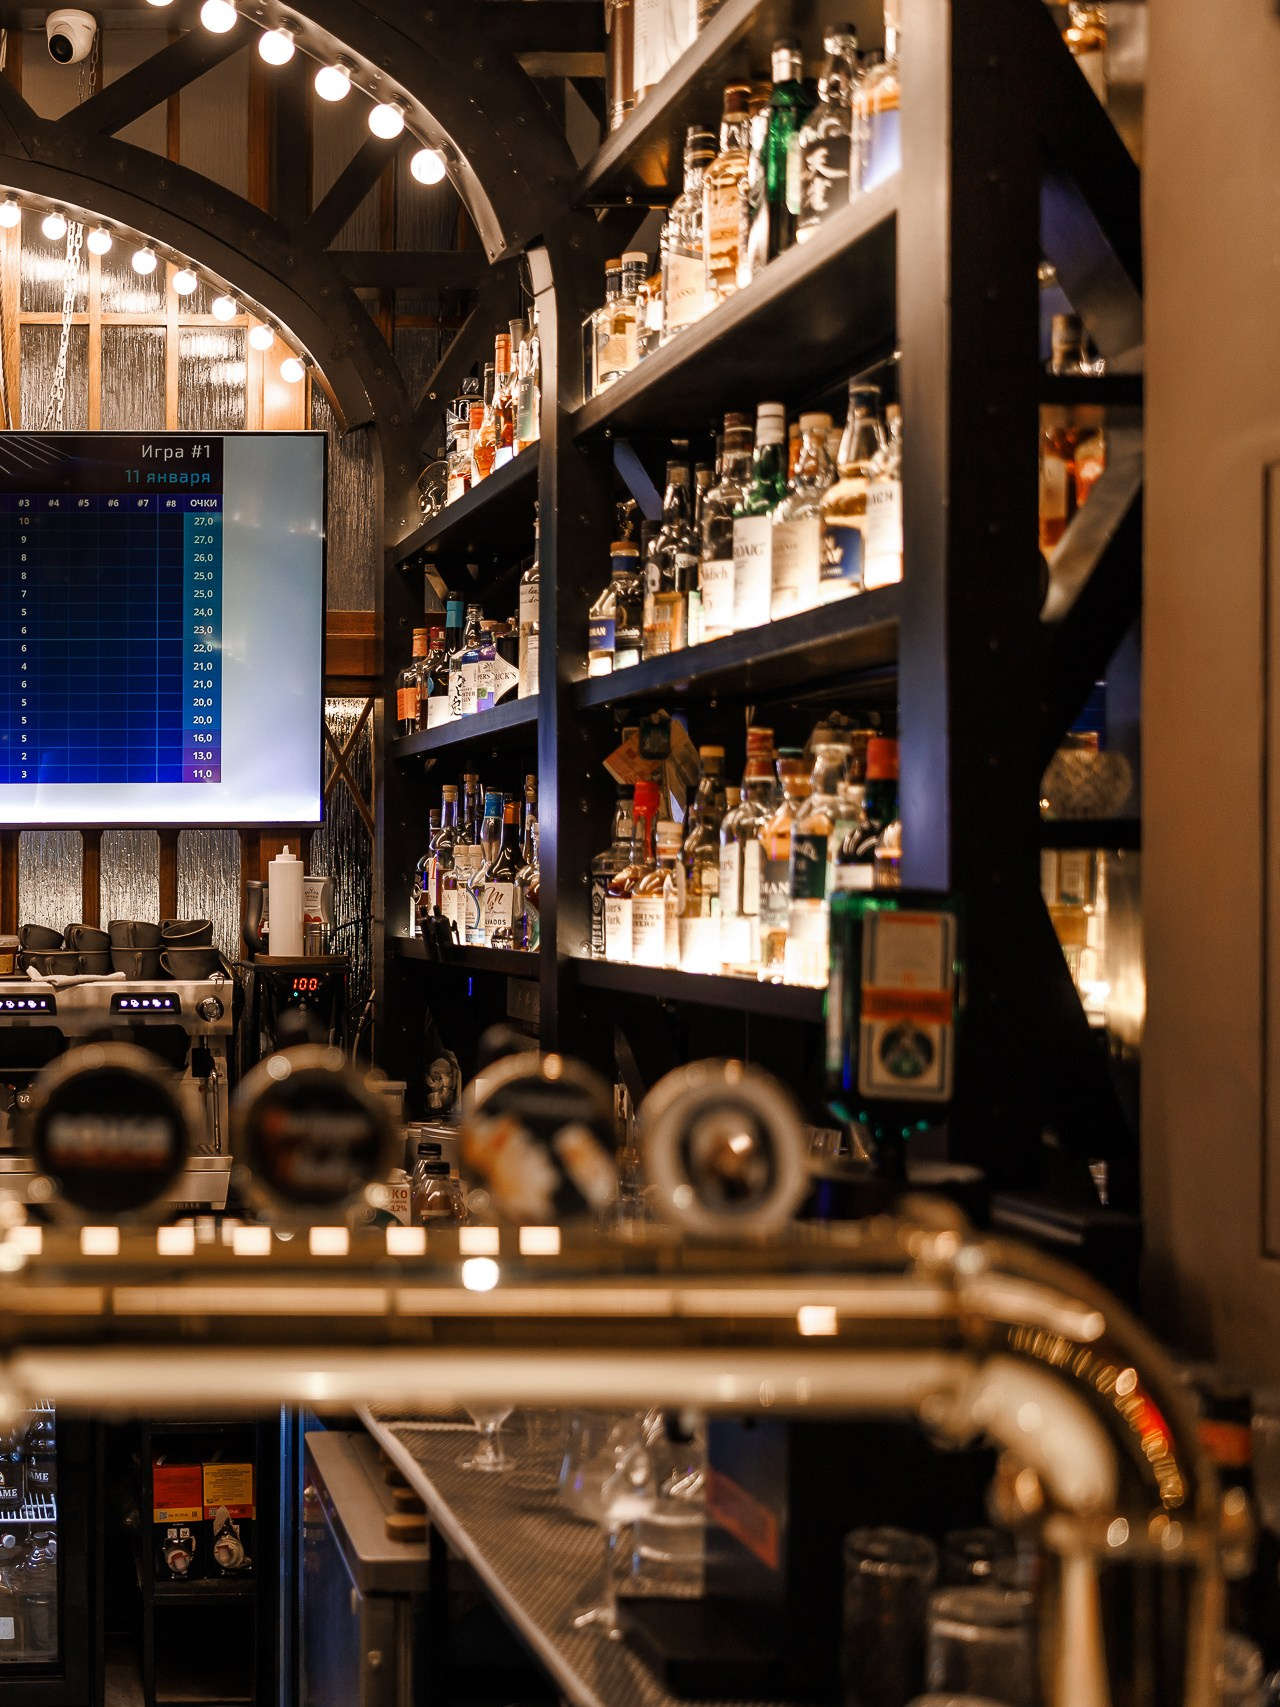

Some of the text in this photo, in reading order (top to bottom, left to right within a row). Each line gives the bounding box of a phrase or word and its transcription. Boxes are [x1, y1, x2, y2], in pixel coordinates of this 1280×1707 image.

[141, 444, 211, 461] Игра #1
[124, 470, 211, 487] 11 января
[18, 499, 30, 508] #3
[48, 499, 60, 508] #4
[78, 499, 90, 508] #5
[108, 499, 119, 508] #6
[137, 499, 149, 508] #7
[166, 499, 177, 508] #8
[190, 499, 218, 508] ОЧКИ
[18, 517, 30, 525] 10
[194, 517, 214, 527] 27,0
[21, 535, 27, 544] 9
[193, 535, 214, 545] 27,0
[21, 553, 27, 562] 8
[193, 553, 214, 563] 26,0
[21, 571, 27, 580] 8
[193, 571, 213, 581] 25,0
[21, 589, 27, 598] 7
[193, 589, 213, 599] 25,0
[21, 608, 27, 616] 5
[193, 607, 213, 617] 24,0
[21, 626, 27, 635] 6
[193, 625, 213, 636] 23,0
[21, 644, 27, 653] 6
[193, 643, 213, 654] 22,0
[21, 662, 27, 671] 4
[193, 662, 213, 672] 21,0
[21, 680, 27, 689] 6
[193, 679, 213, 690] 21,0
[21, 698, 27, 707] 5
[193, 697, 213, 708] 20,0
[21, 716, 27, 725] 5
[192, 715, 213, 726] 20,0
[21, 734, 27, 743] 5
[193, 733, 213, 744] 16,0
[21, 752, 27, 761] 2
[192, 751, 213, 761] 13,0
[21, 770, 28, 779] 3
[193, 769, 213, 780] 11,0
[293, 977, 318, 991] 100
